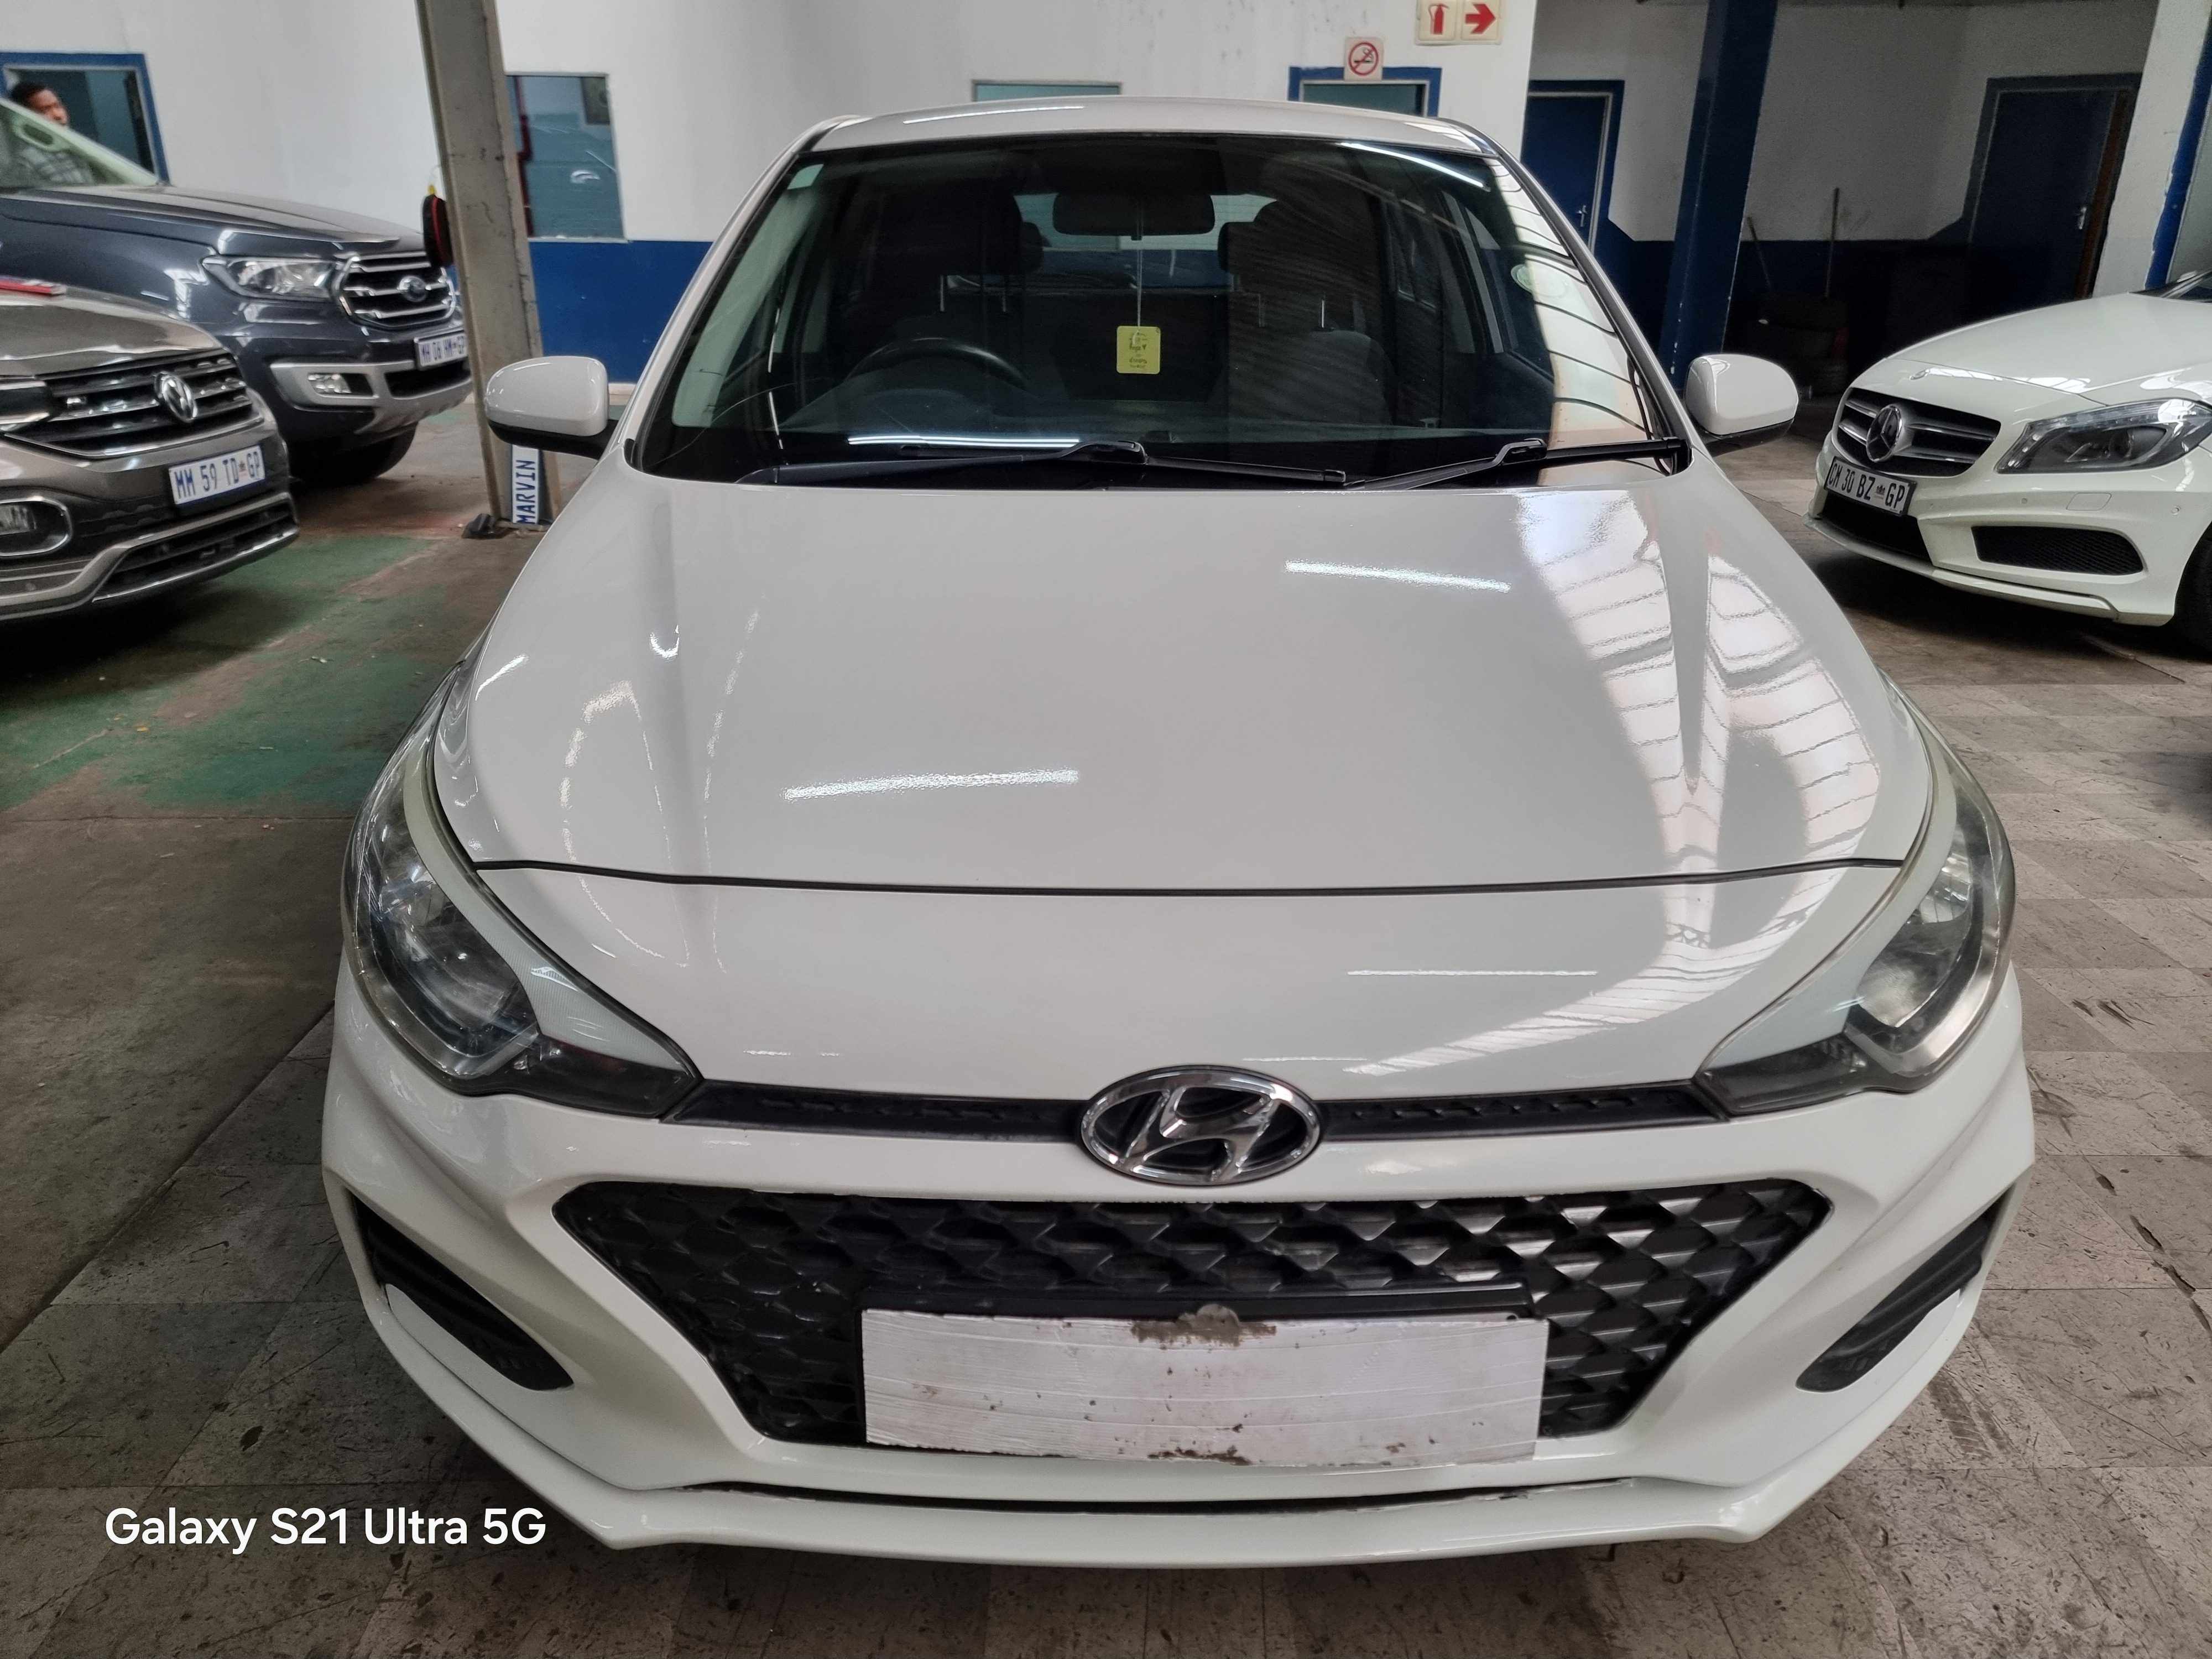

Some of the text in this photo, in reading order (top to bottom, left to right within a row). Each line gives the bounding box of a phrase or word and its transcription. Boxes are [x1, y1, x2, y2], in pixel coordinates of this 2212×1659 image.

[174, 451, 259, 499] MM 59 TD GP
[516, 460, 535, 524] MARVIN
[1829, 463, 1906, 509] CM 30 BZ GP
